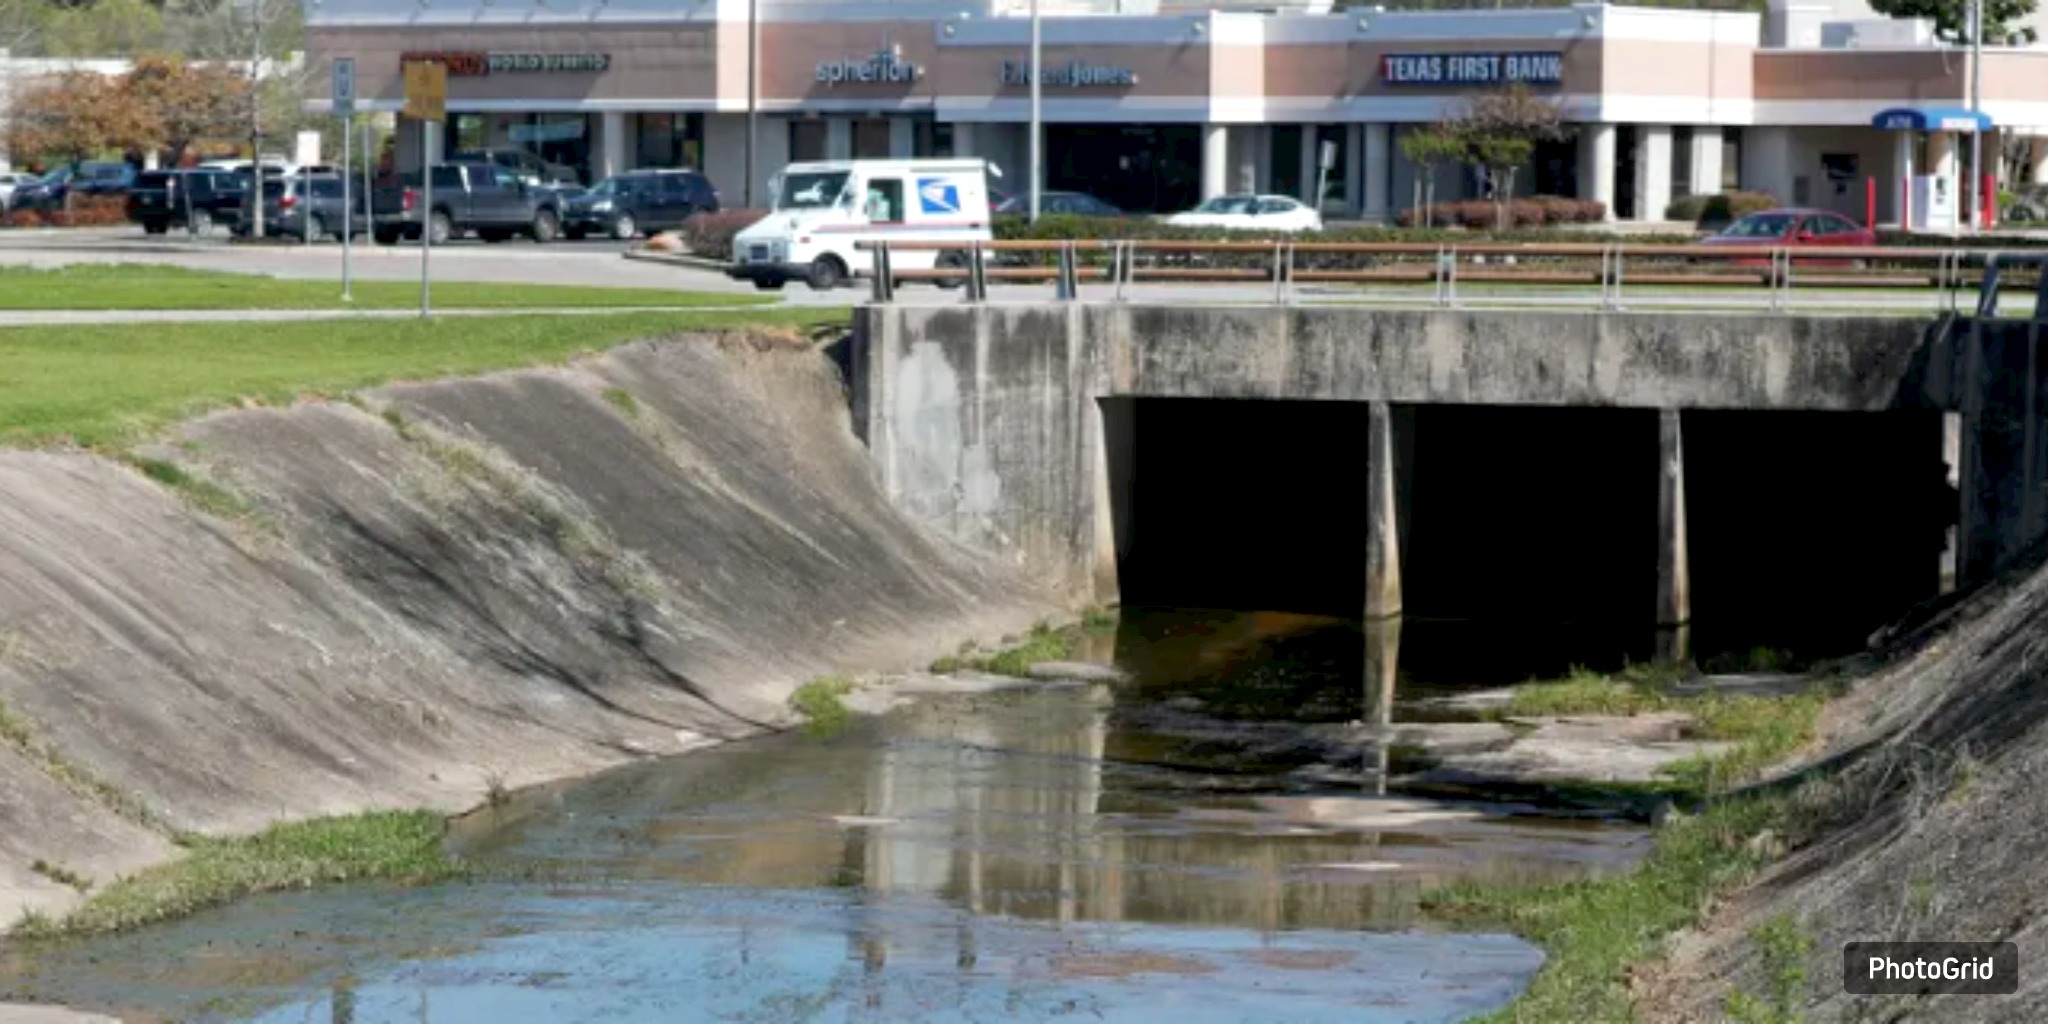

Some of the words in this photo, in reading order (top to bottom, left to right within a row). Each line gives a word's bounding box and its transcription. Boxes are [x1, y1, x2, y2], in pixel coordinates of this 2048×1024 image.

[815, 56, 917, 88] spherion
[1386, 55, 1442, 81] TEXAS
[1449, 55, 1500, 80] FIRST
[1506, 55, 1562, 79] BANK
